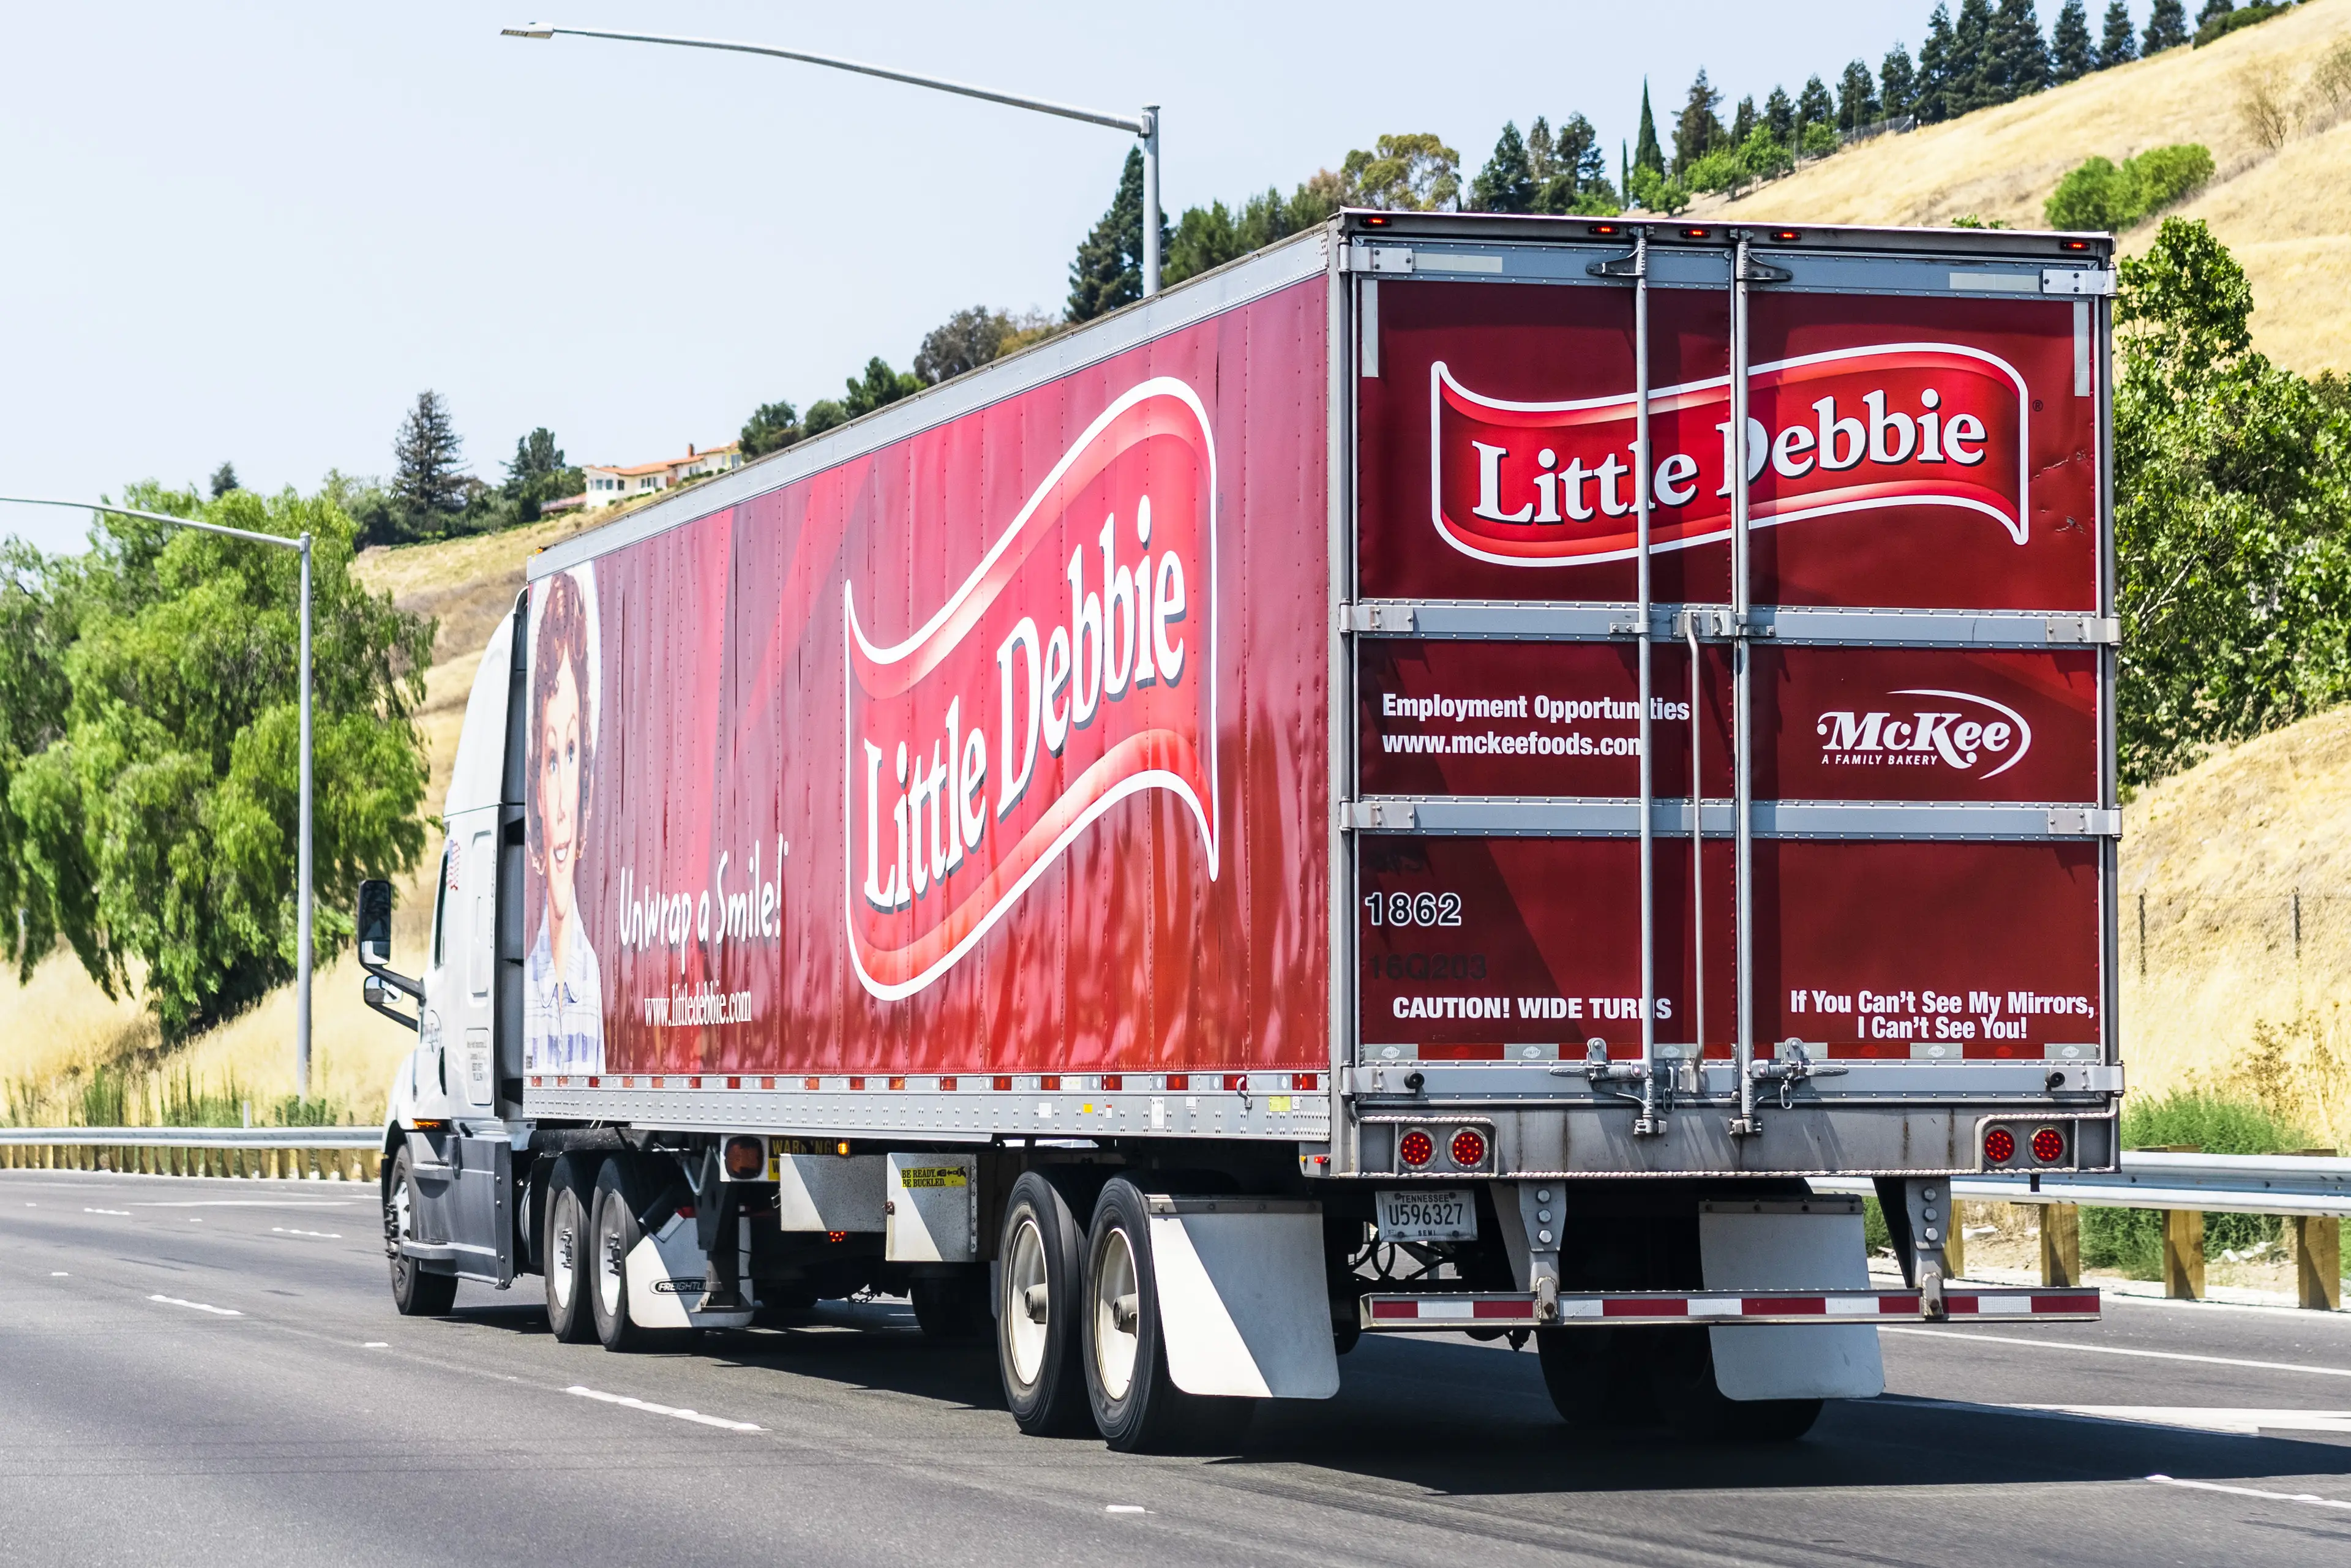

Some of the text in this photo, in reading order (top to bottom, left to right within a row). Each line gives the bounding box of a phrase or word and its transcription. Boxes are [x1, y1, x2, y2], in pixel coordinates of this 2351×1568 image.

[1715, 388, 1986, 496] Debbie
[864, 495, 1185, 913] Little Debbie
[1383, 693, 1690, 723] Employment Opportunties
[1817, 711, 2011, 769] McKee
[1822, 754, 1938, 765] A FAMILY BAKERY
[620, 833, 784, 974] Unwrap a Smile!
[1365, 892, 1462, 926] 1862
[644, 980, 752, 1027] www.littledebbie.com
[1393, 997, 1510, 1019] CAUTION!
[1518, 997, 1583, 1019] WIDE
[1791, 989, 2094, 1019] If You Can't See My Mirrors,
[1858, 1016, 2028, 1039] I Can't See You!
[901, 1169, 936, 1179] BE READY.
[902, 1178, 946, 1188] BE BUCKLED.
[1401, 1194, 1450, 1203] TENNESSEE
[1389, 1203, 1463, 1226] U596327
